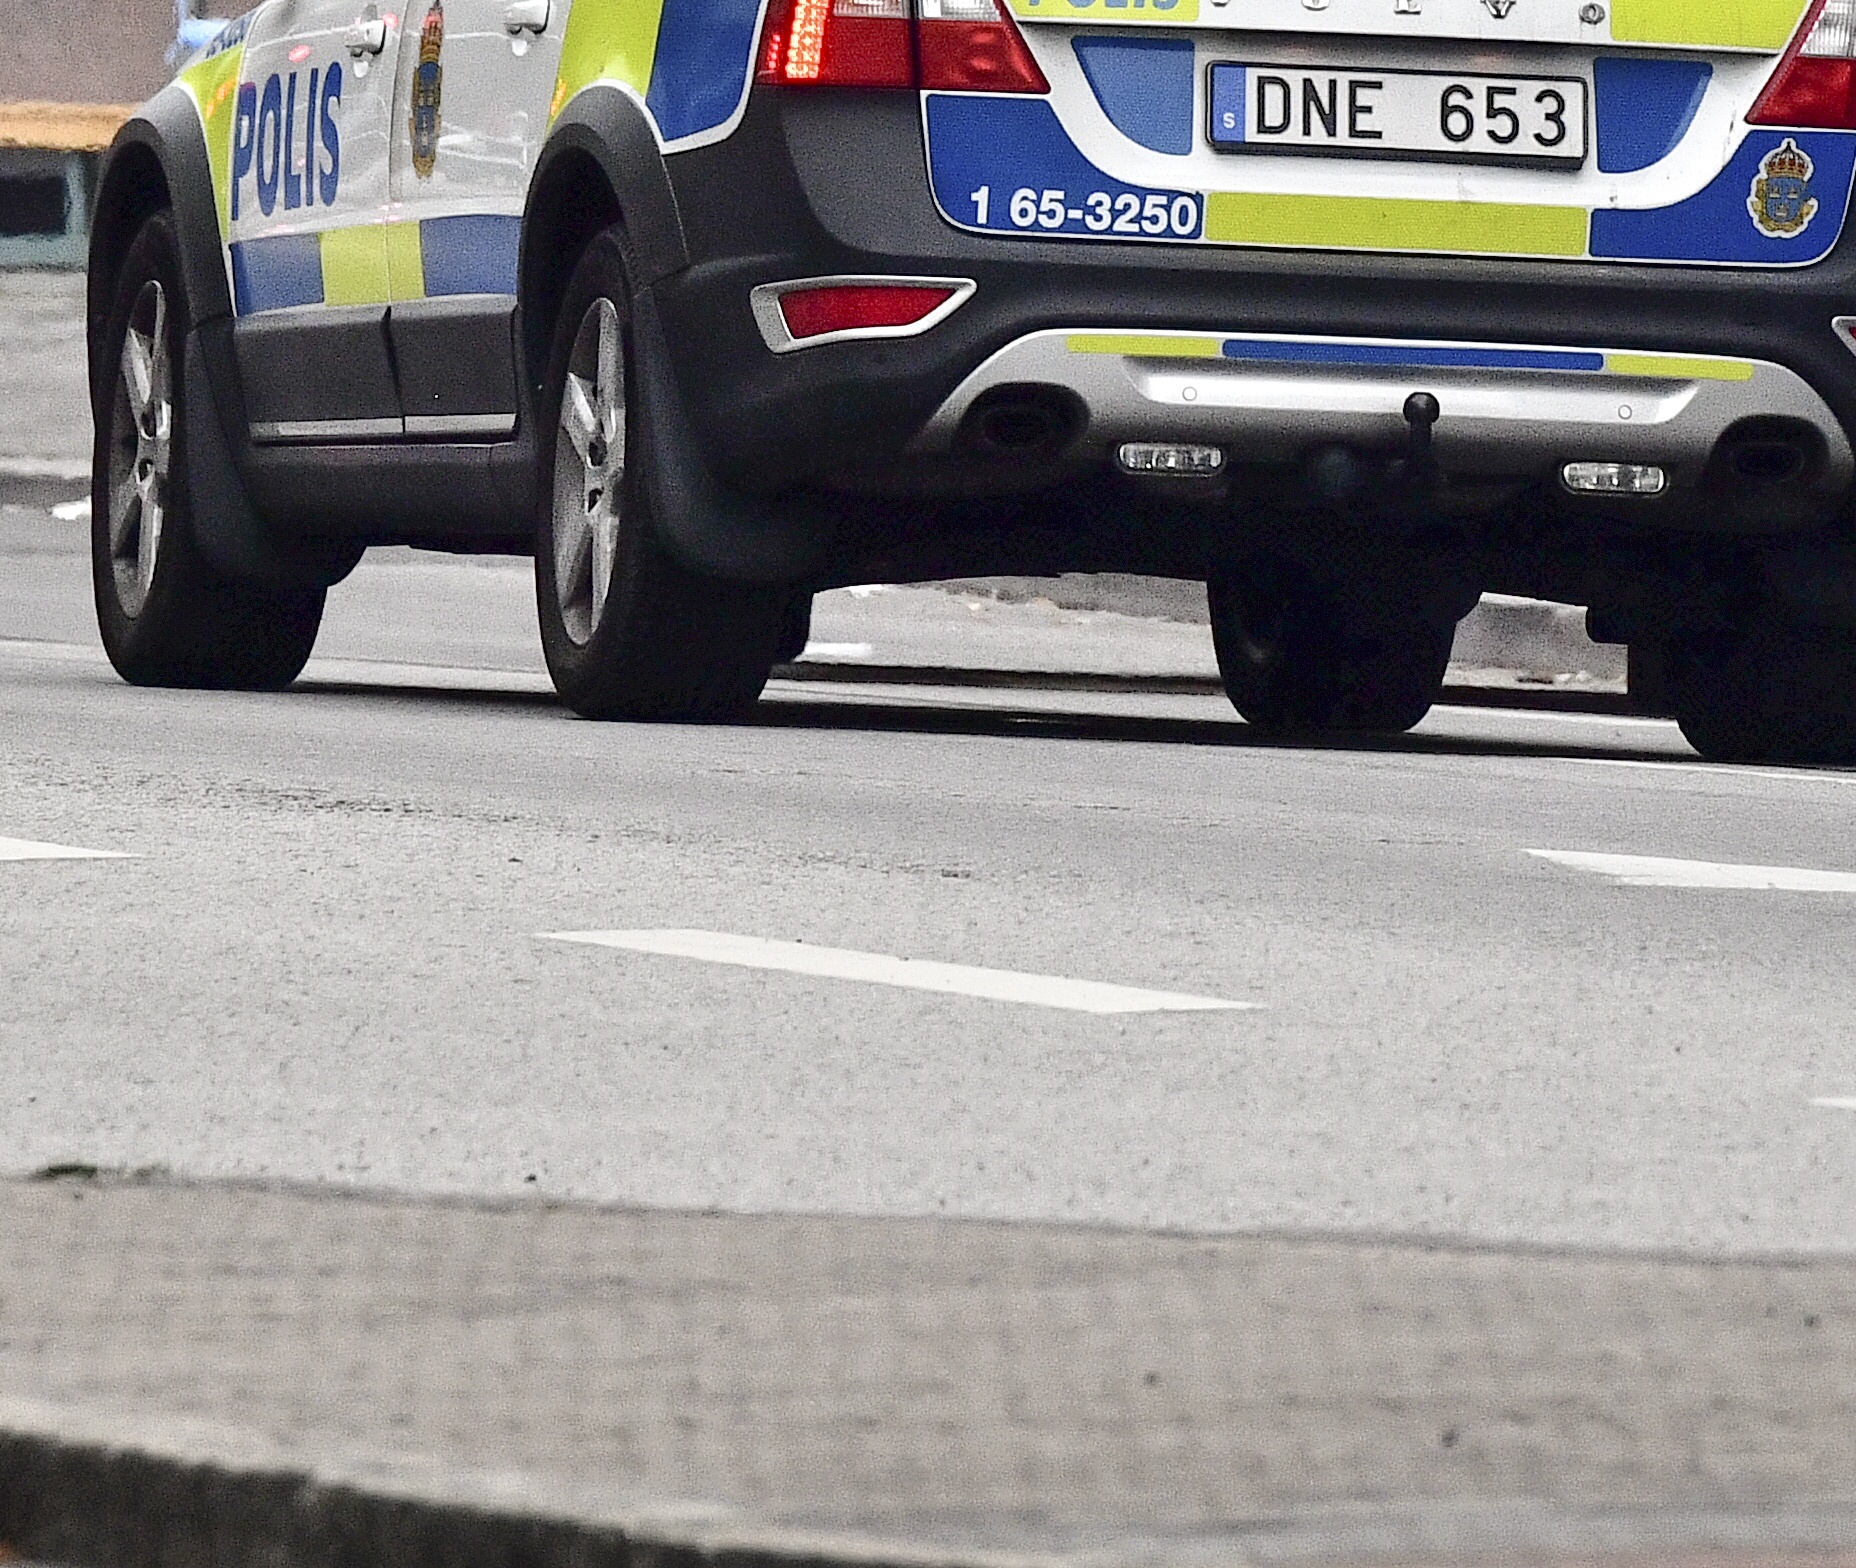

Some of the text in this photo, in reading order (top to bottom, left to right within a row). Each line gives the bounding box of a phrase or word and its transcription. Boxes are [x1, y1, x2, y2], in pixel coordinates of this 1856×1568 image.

[1223, 111, 1237, 130] S
[1255, 74, 1567, 147] DNE 653
[231, 61, 343, 222] POLIS
[970, 186, 1198, 235] 1 65-3250
